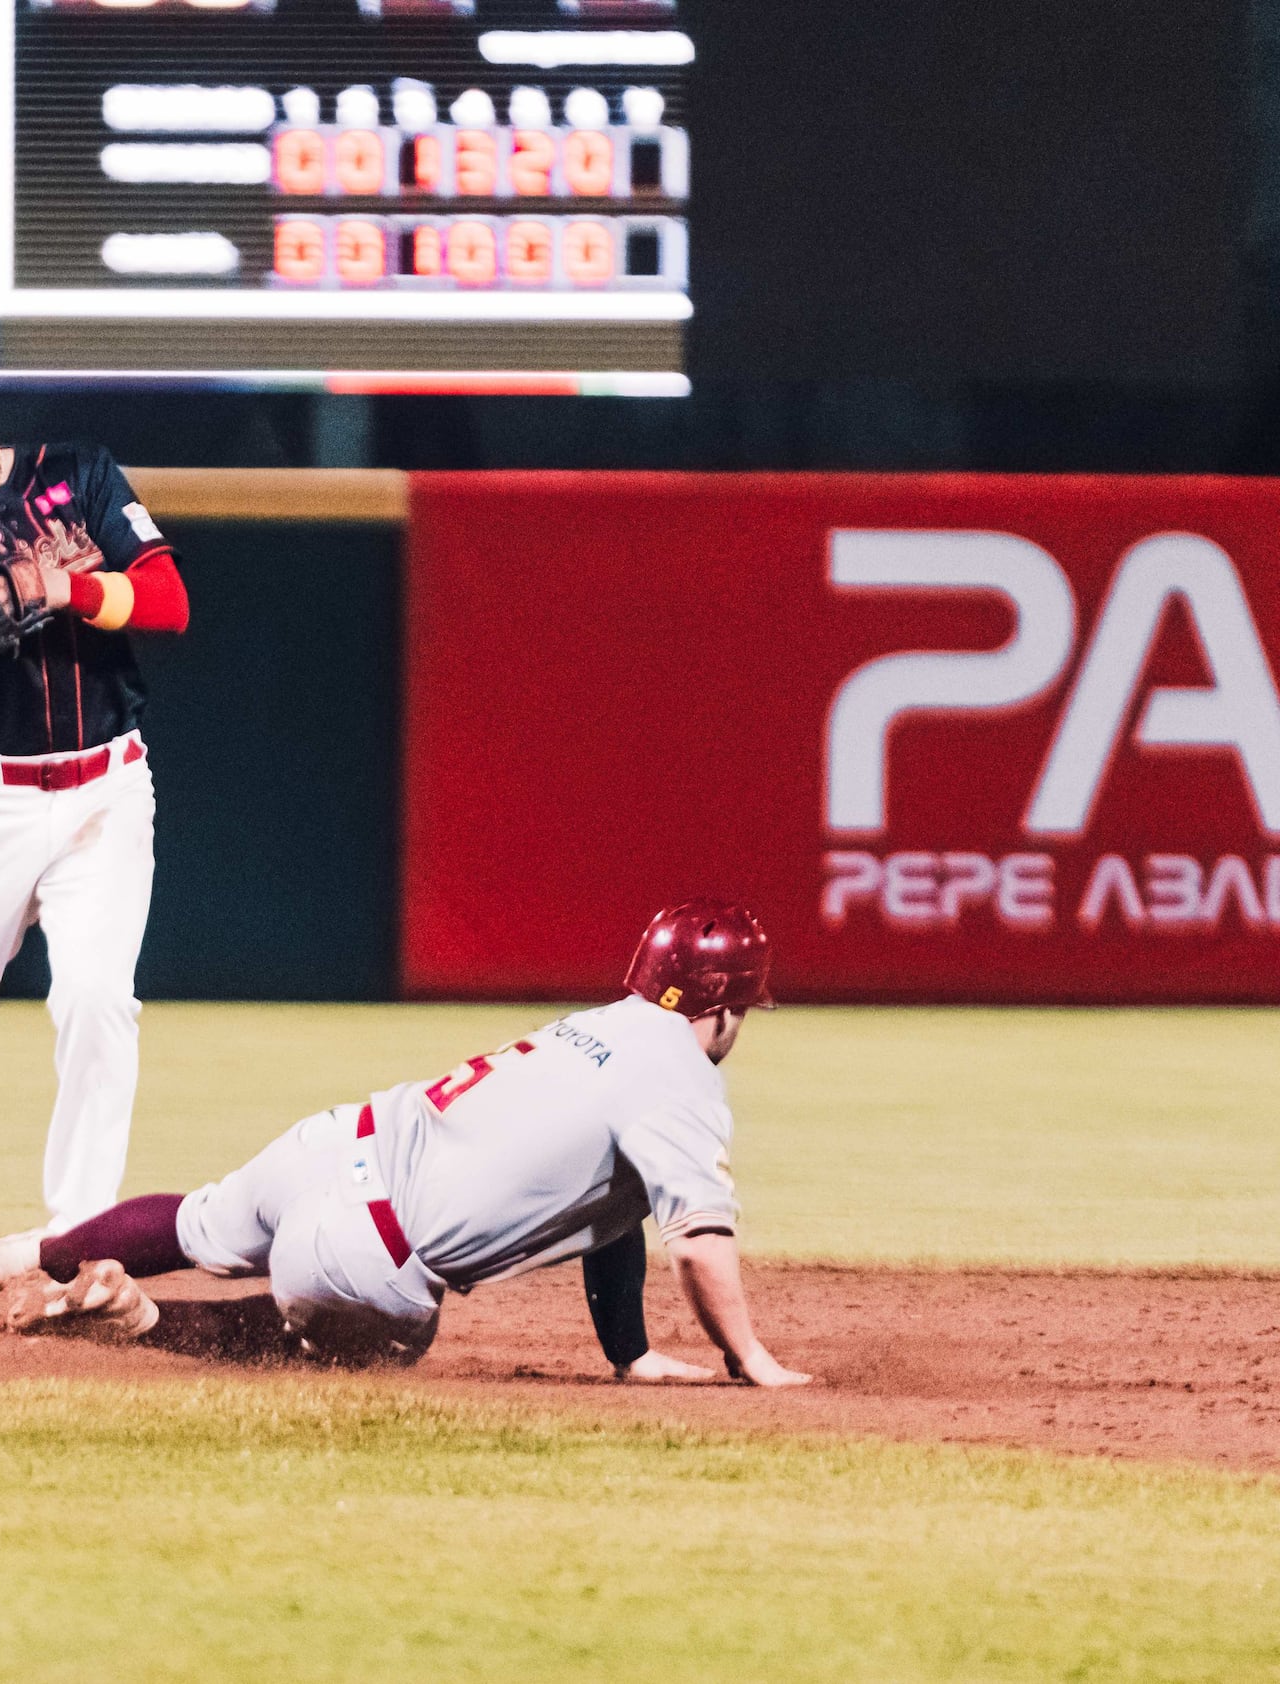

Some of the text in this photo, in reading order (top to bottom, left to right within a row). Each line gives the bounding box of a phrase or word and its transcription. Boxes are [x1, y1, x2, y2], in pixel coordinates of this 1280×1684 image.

[827, 529, 1280, 832] PA
[826, 853, 1280, 922] PEPE ABA
[660, 986, 684, 1010] 5
